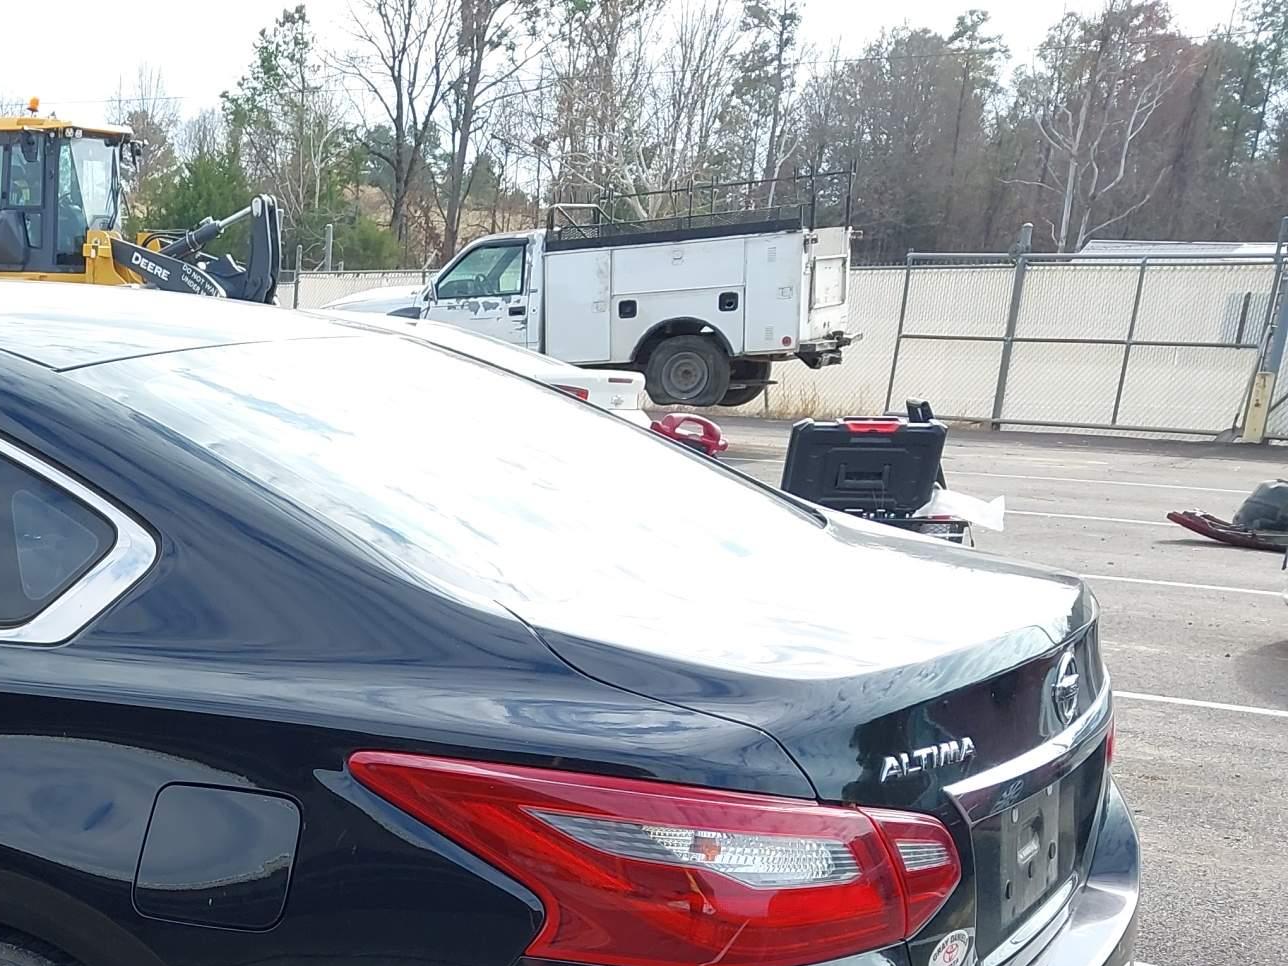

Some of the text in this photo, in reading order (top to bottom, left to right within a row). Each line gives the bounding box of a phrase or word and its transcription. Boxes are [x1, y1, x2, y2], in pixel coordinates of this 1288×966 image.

[131, 251, 171, 281] DEERE
[182, 263, 193, 275] DO
[191, 271, 205, 285] NOT
[879, 736, 976, 784] ALTIMA
